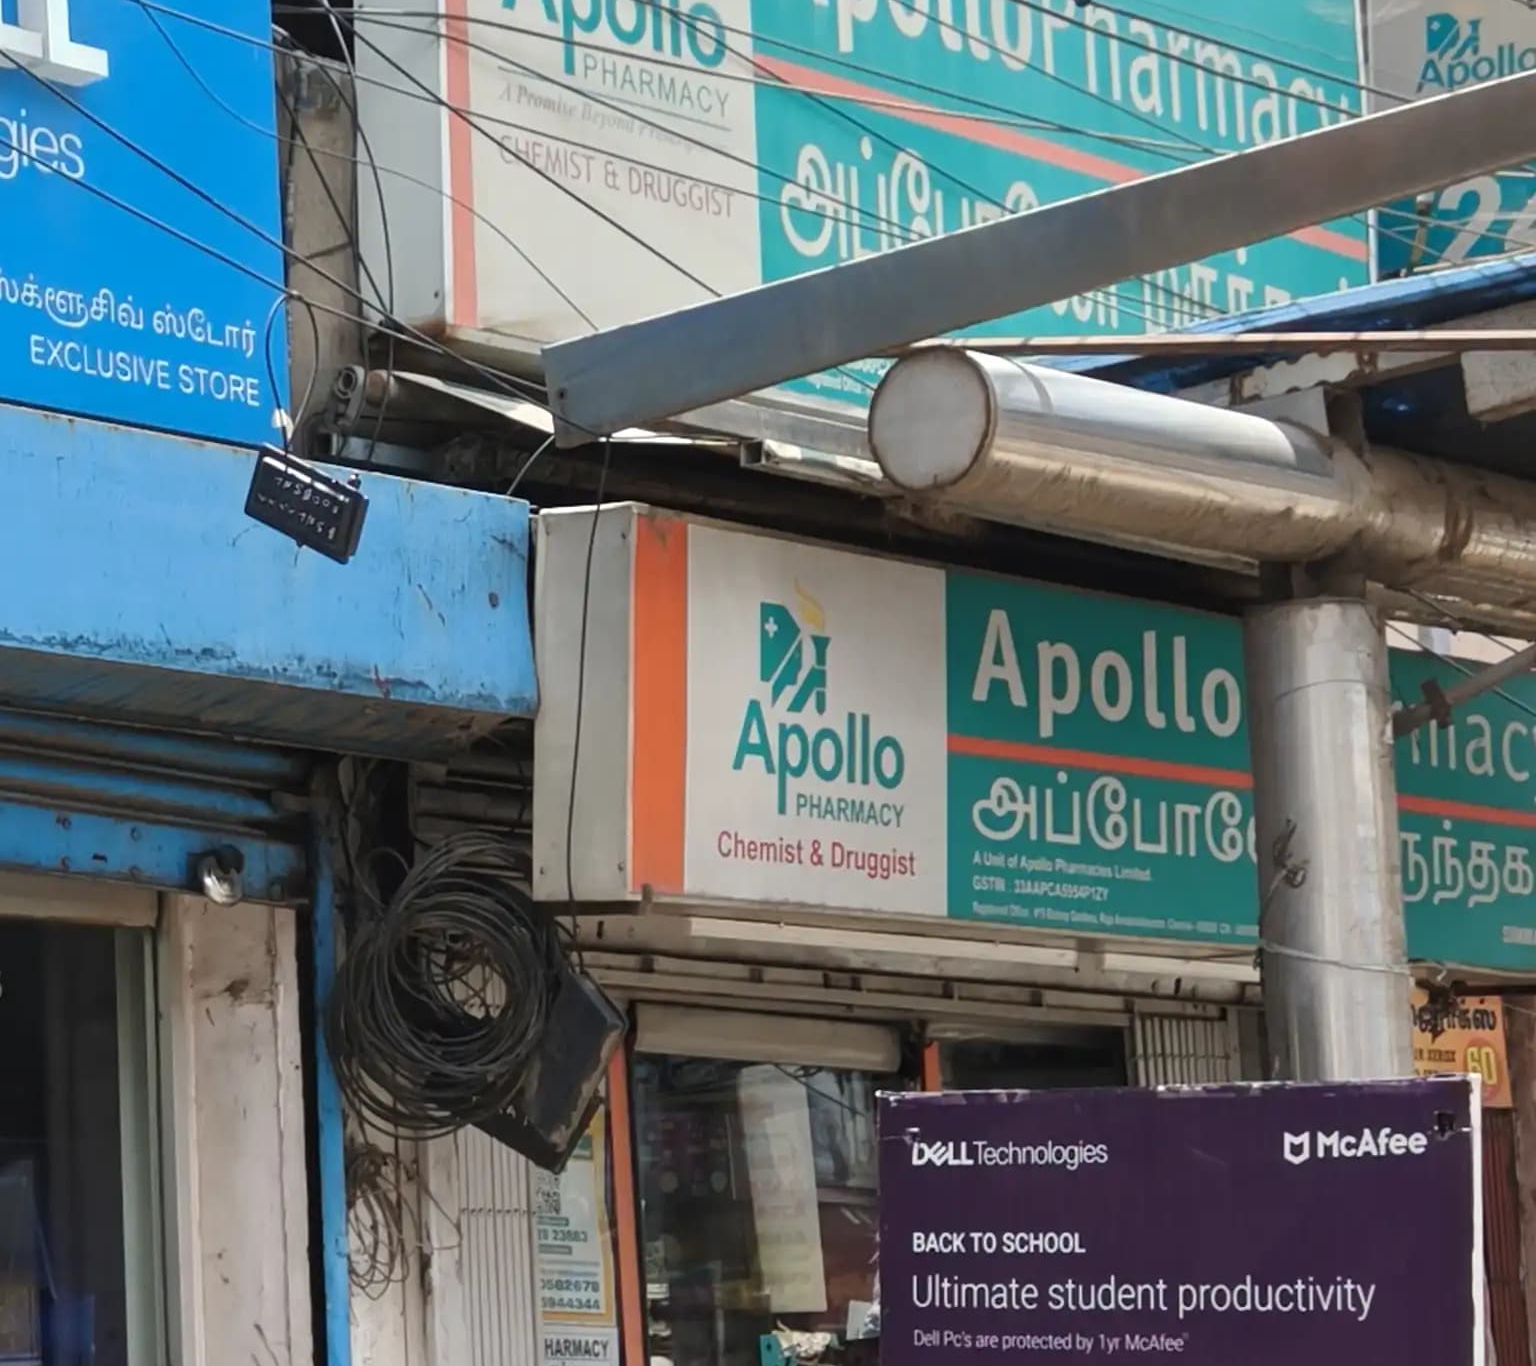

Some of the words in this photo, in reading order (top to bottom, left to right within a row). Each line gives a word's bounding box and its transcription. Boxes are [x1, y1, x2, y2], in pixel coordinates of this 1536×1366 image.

[583, 52, 730, 118] PHARMACY
[499, 135, 596, 185] CHEMIST
[604, 160, 619, 191] &
[628, 166, 735, 218] DRUGGIST
[153, 304, 257, 358] ஸ்டோர்
[30, 334, 170, 389] EXCLUSIVE
[178, 364, 261, 407] STORE
[972, 609, 1241, 738] Apollo
[732, 699, 905, 815] Apollo
[796, 793, 905, 828] PHARMACY
[718, 830, 803, 865] Chemist
[810, 839, 824, 866] &
[831, 842, 916, 880] Druggist
[972, 850, 981, 865] A
[1007, 853, 1018, 867] of
[912, 1141, 974, 1167] DELL
[974, 1140, 1109, 1171] Technologies
[1317, 1127, 1428, 1160] McAfee
[912, 1232, 965, 1254] BACK
[970, 1232, 997, 1254] TO
[1002, 1232, 1086, 1254] SCHOOL
[912, 1274, 1039, 1311] Ultimate
[1047, 1276, 1168, 1312] student
[1178, 1276, 1375, 1321] productivity
[544, 1338, 609, 1358] HARMACY
[913, 1329, 941, 1347] Dell
[975, 1334, 999, 1349] are
[1002, 1332, 1072, 1353] protected
[1075, 1333, 1094, 1354] by
[1098, 1333, 1120, 1354] 1yr
